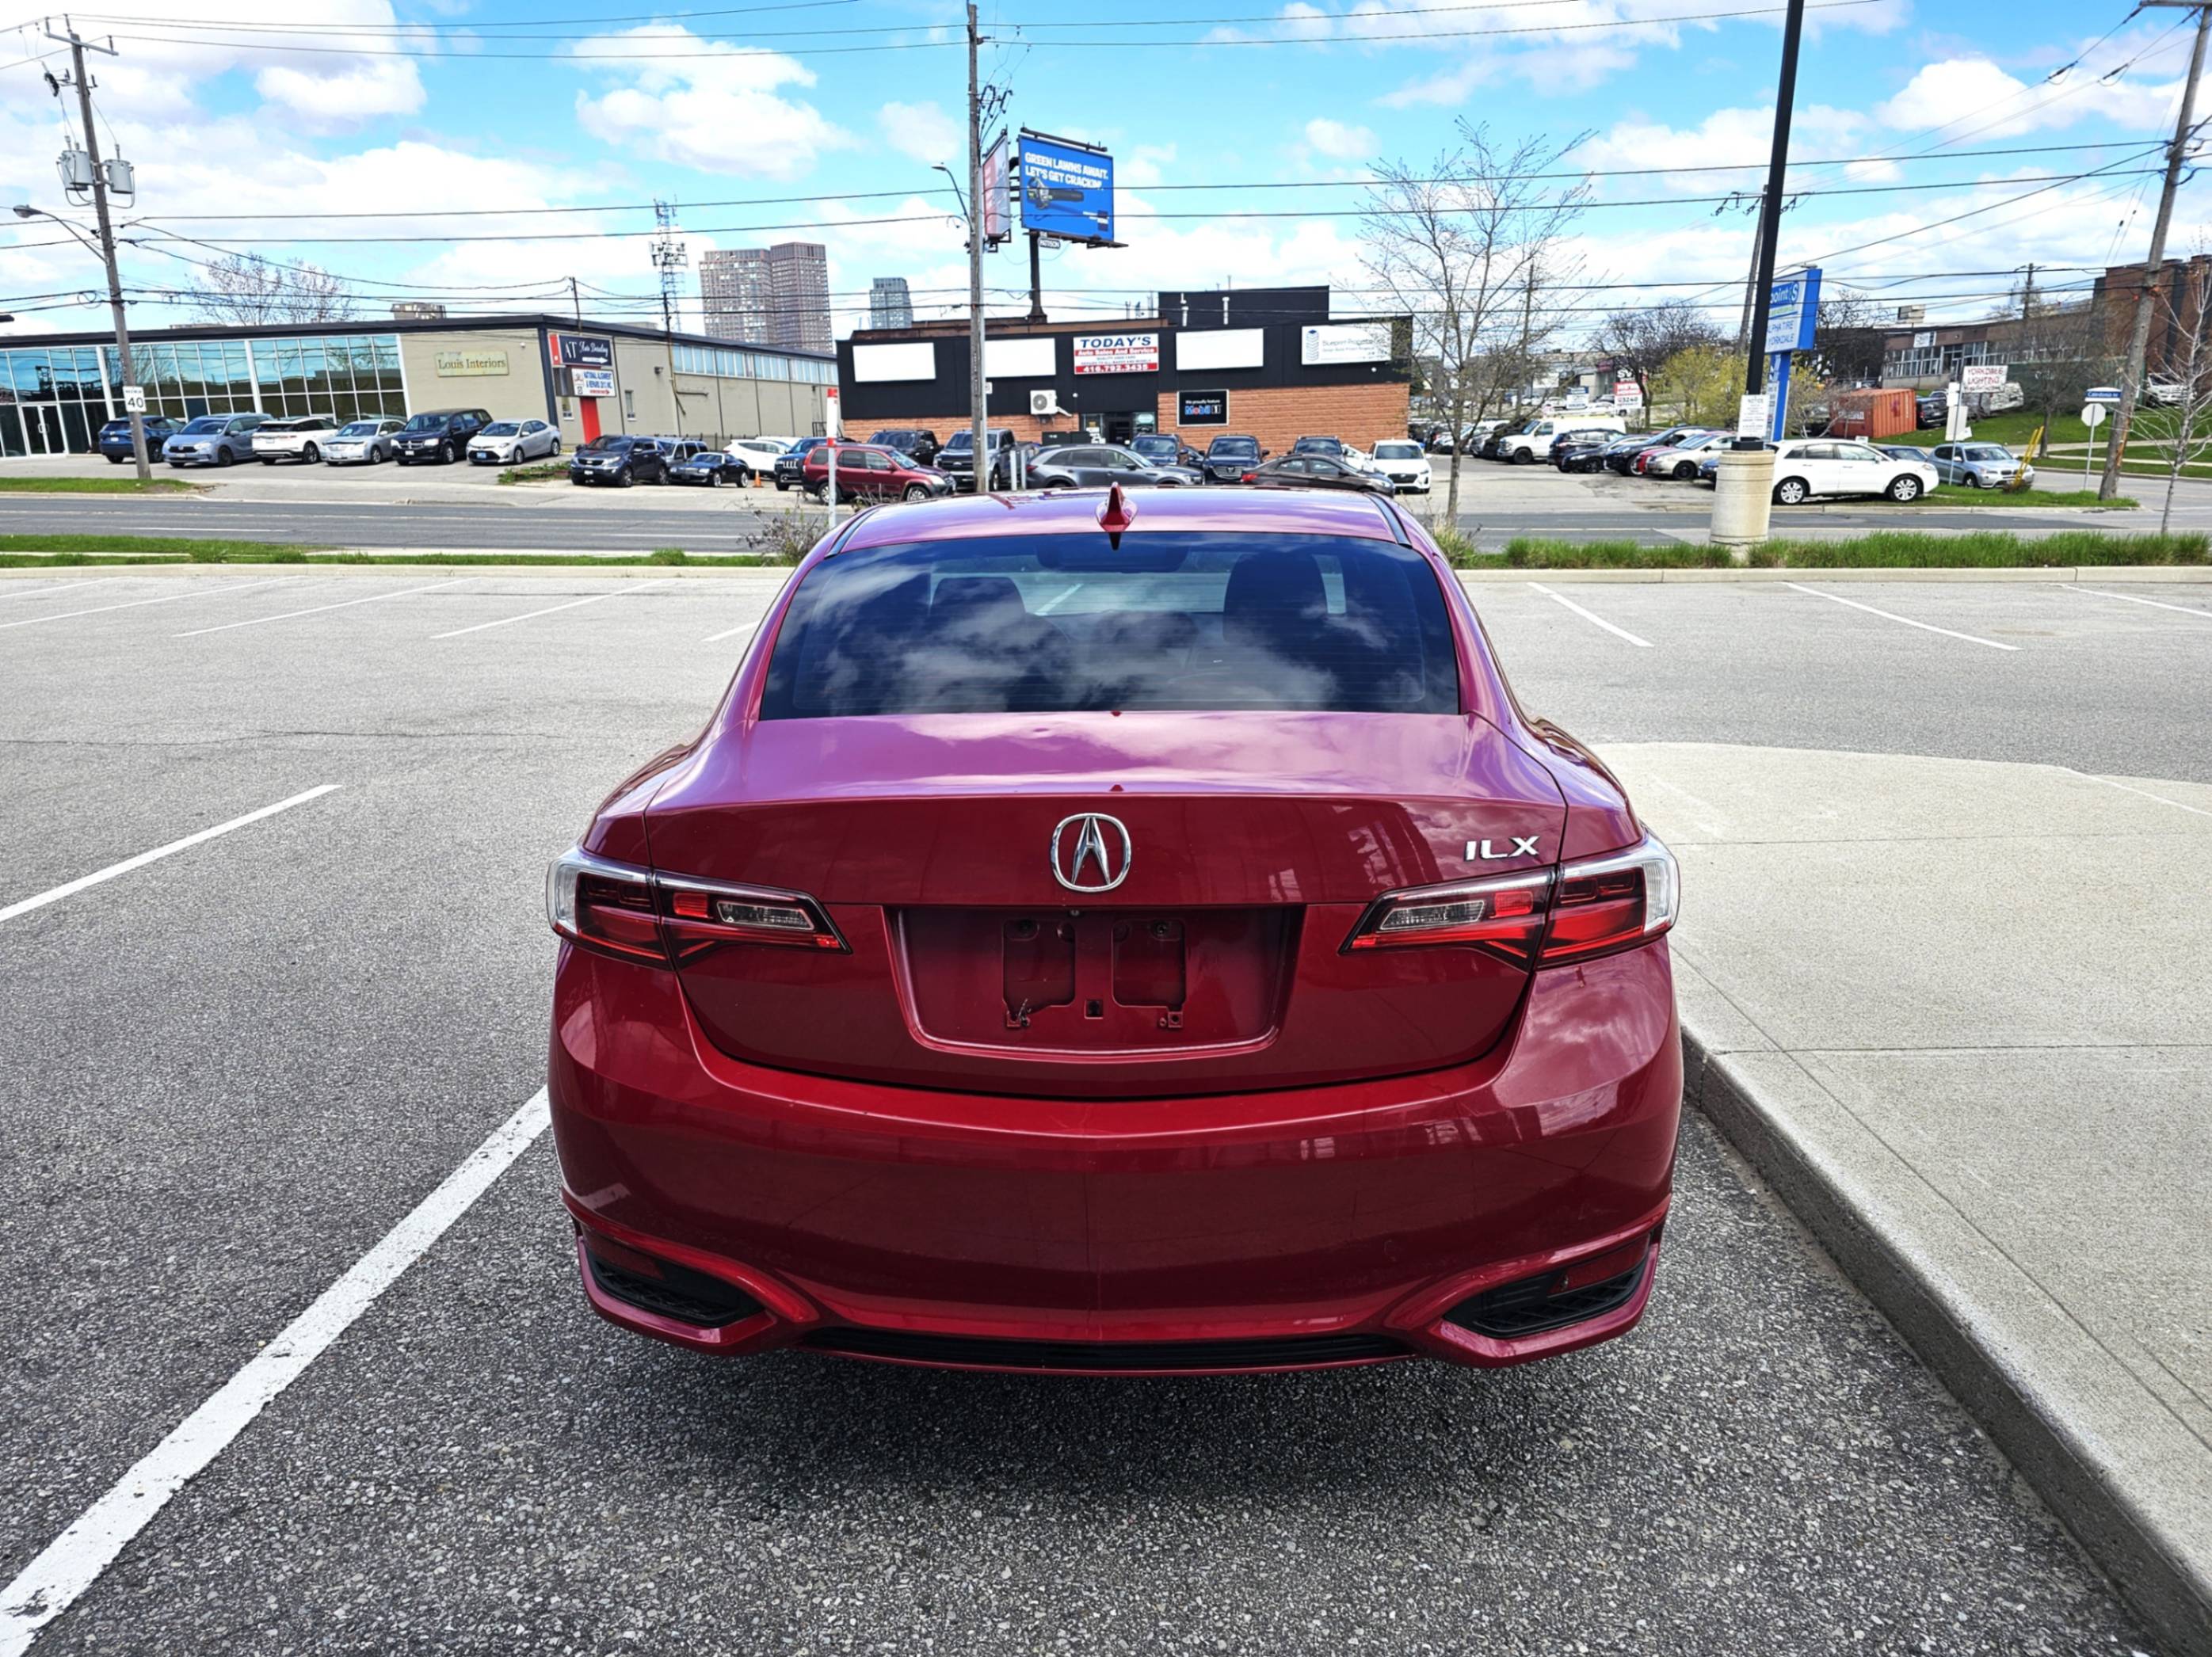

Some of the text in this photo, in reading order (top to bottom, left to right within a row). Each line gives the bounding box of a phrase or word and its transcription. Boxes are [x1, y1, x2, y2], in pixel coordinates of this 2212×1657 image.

[1024, 151, 1053, 168] GREEN
[1053, 158, 1082, 174] LAWNS
[1024, 165, 1048, 180] LET'S
[1048, 170, 1065, 183] GET
[1080, 336, 1152, 349] TODAY'S
[1129, 345, 1156, 354] Service
[437, 356, 507, 369] Louis Interiors
[128, 397, 144, 408] 40
[1184, 405, 1211, 416] Mobil
[1464, 835, 1541, 862] ILX
